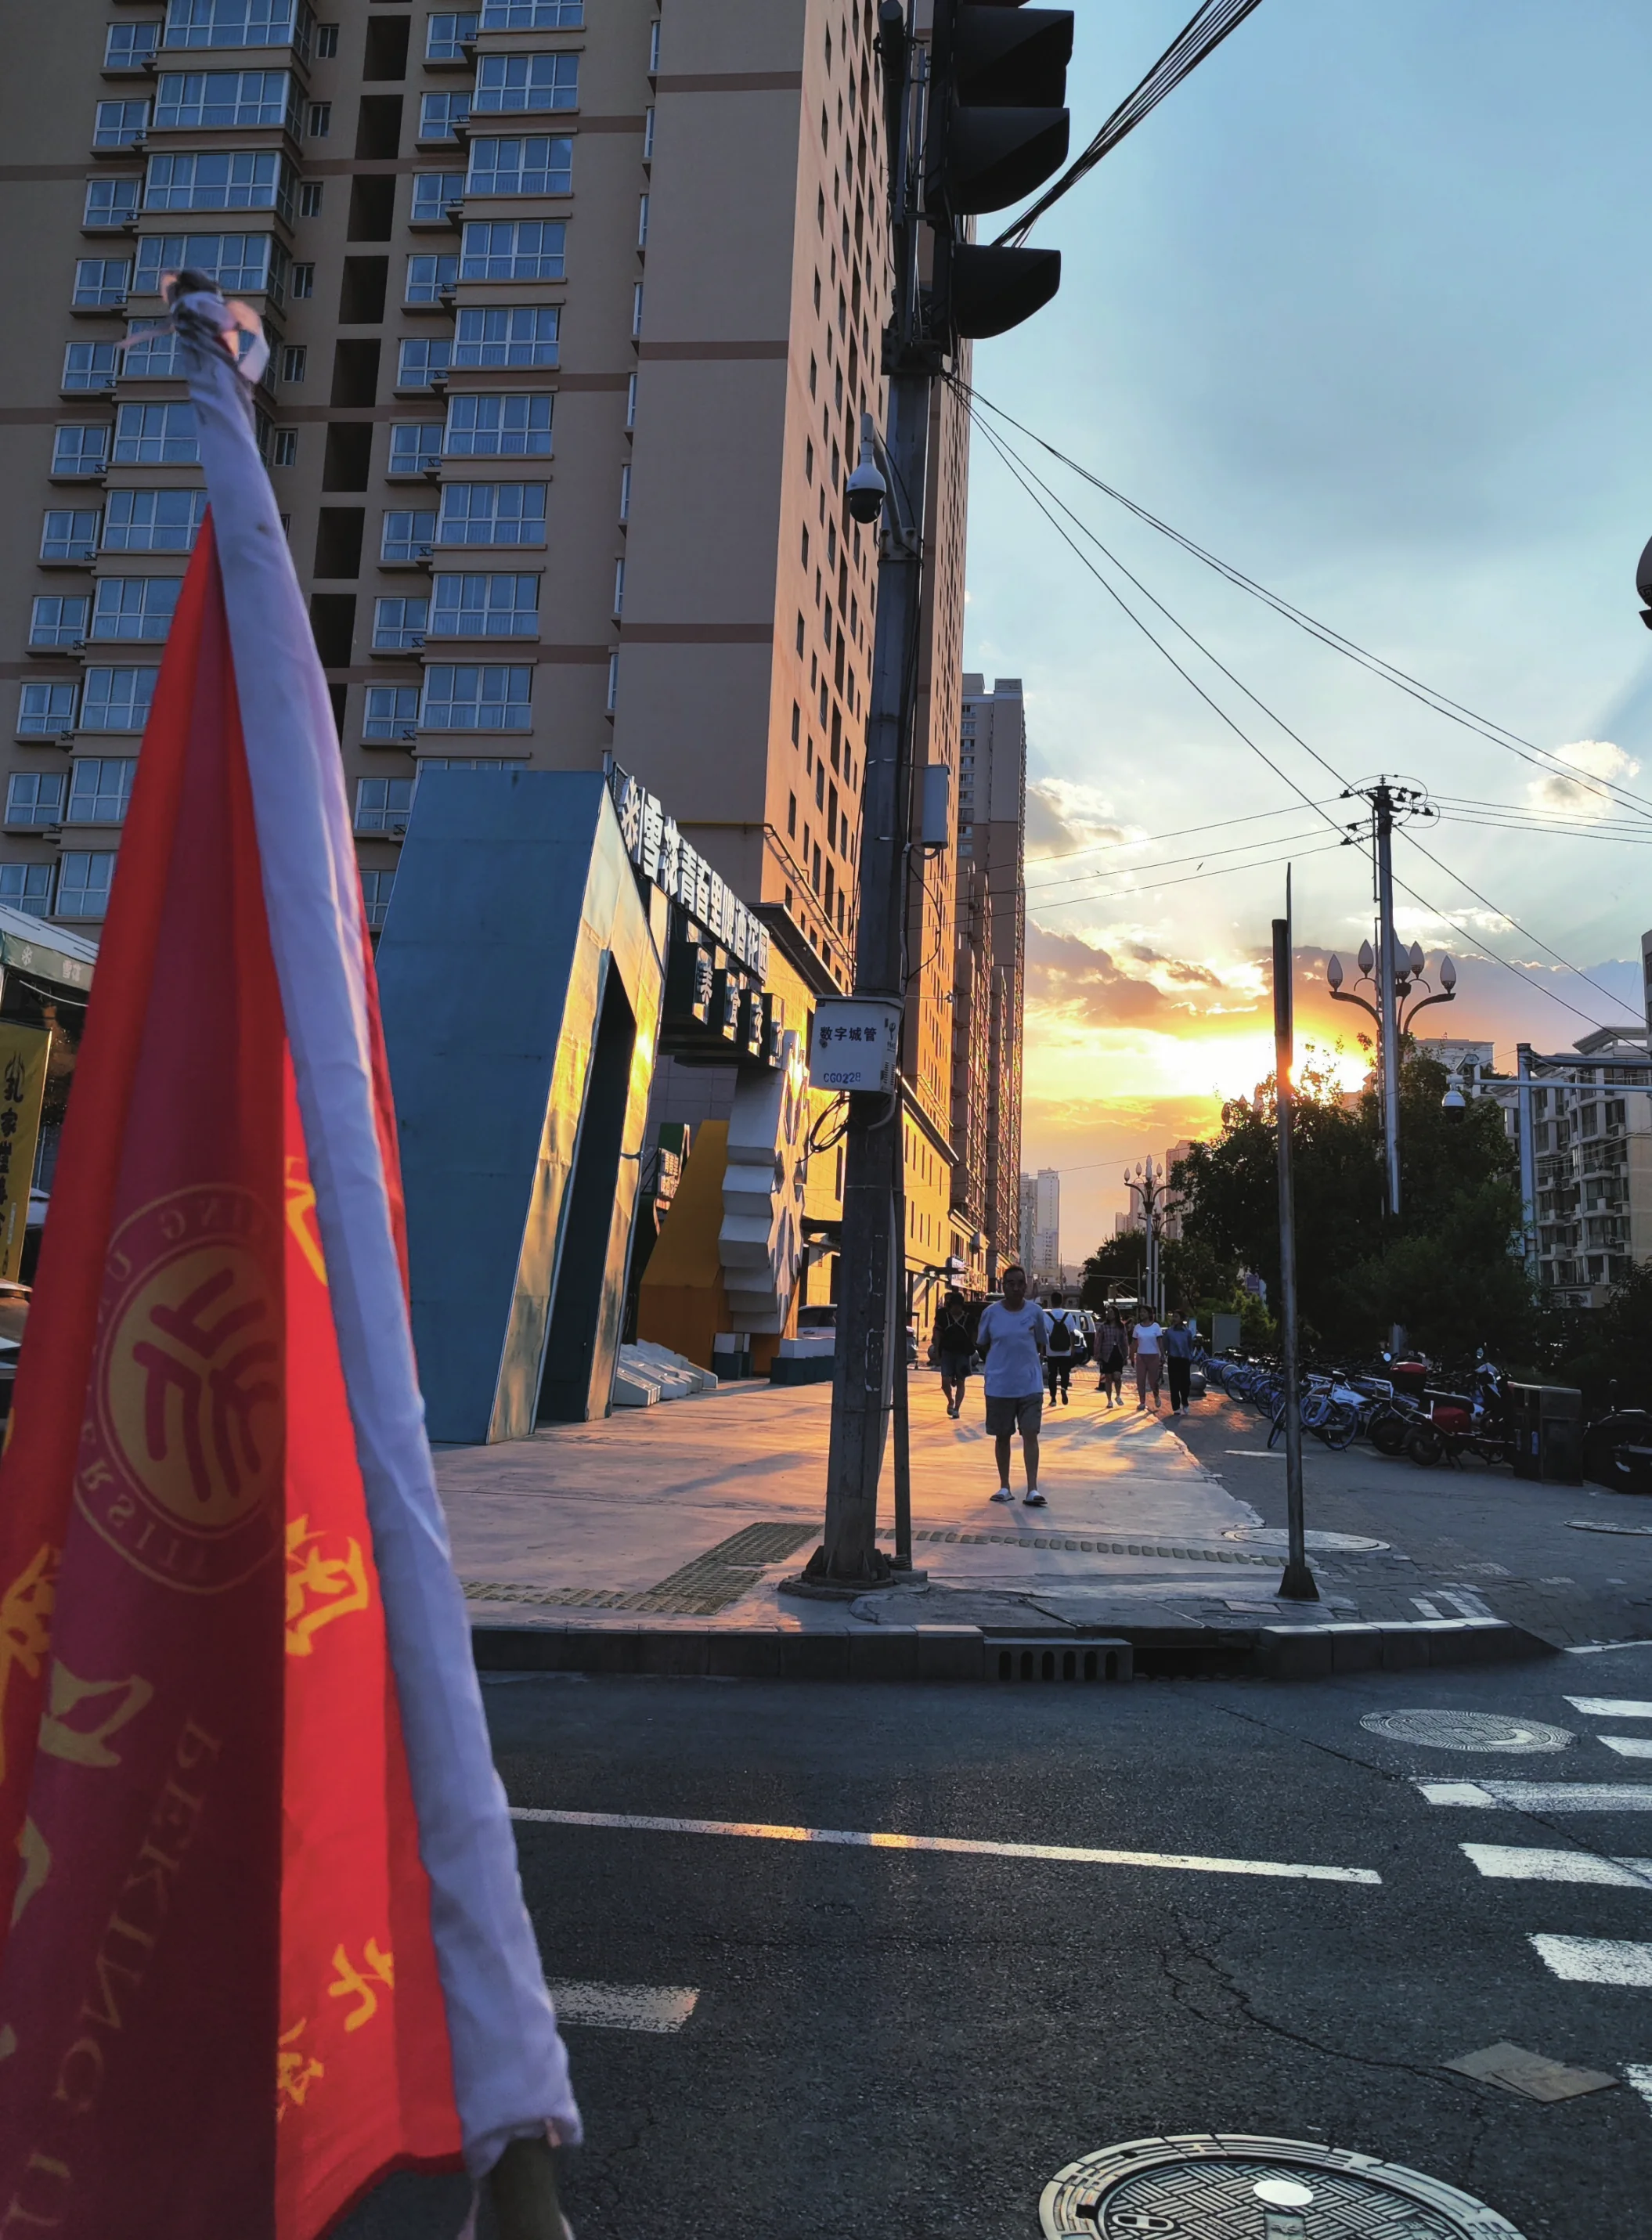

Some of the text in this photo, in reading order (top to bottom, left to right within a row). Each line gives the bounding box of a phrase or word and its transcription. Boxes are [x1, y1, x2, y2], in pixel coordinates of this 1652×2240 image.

[820, 1026, 877, 1041] 数字城管
[823, 1072, 861, 1084] CG0228
